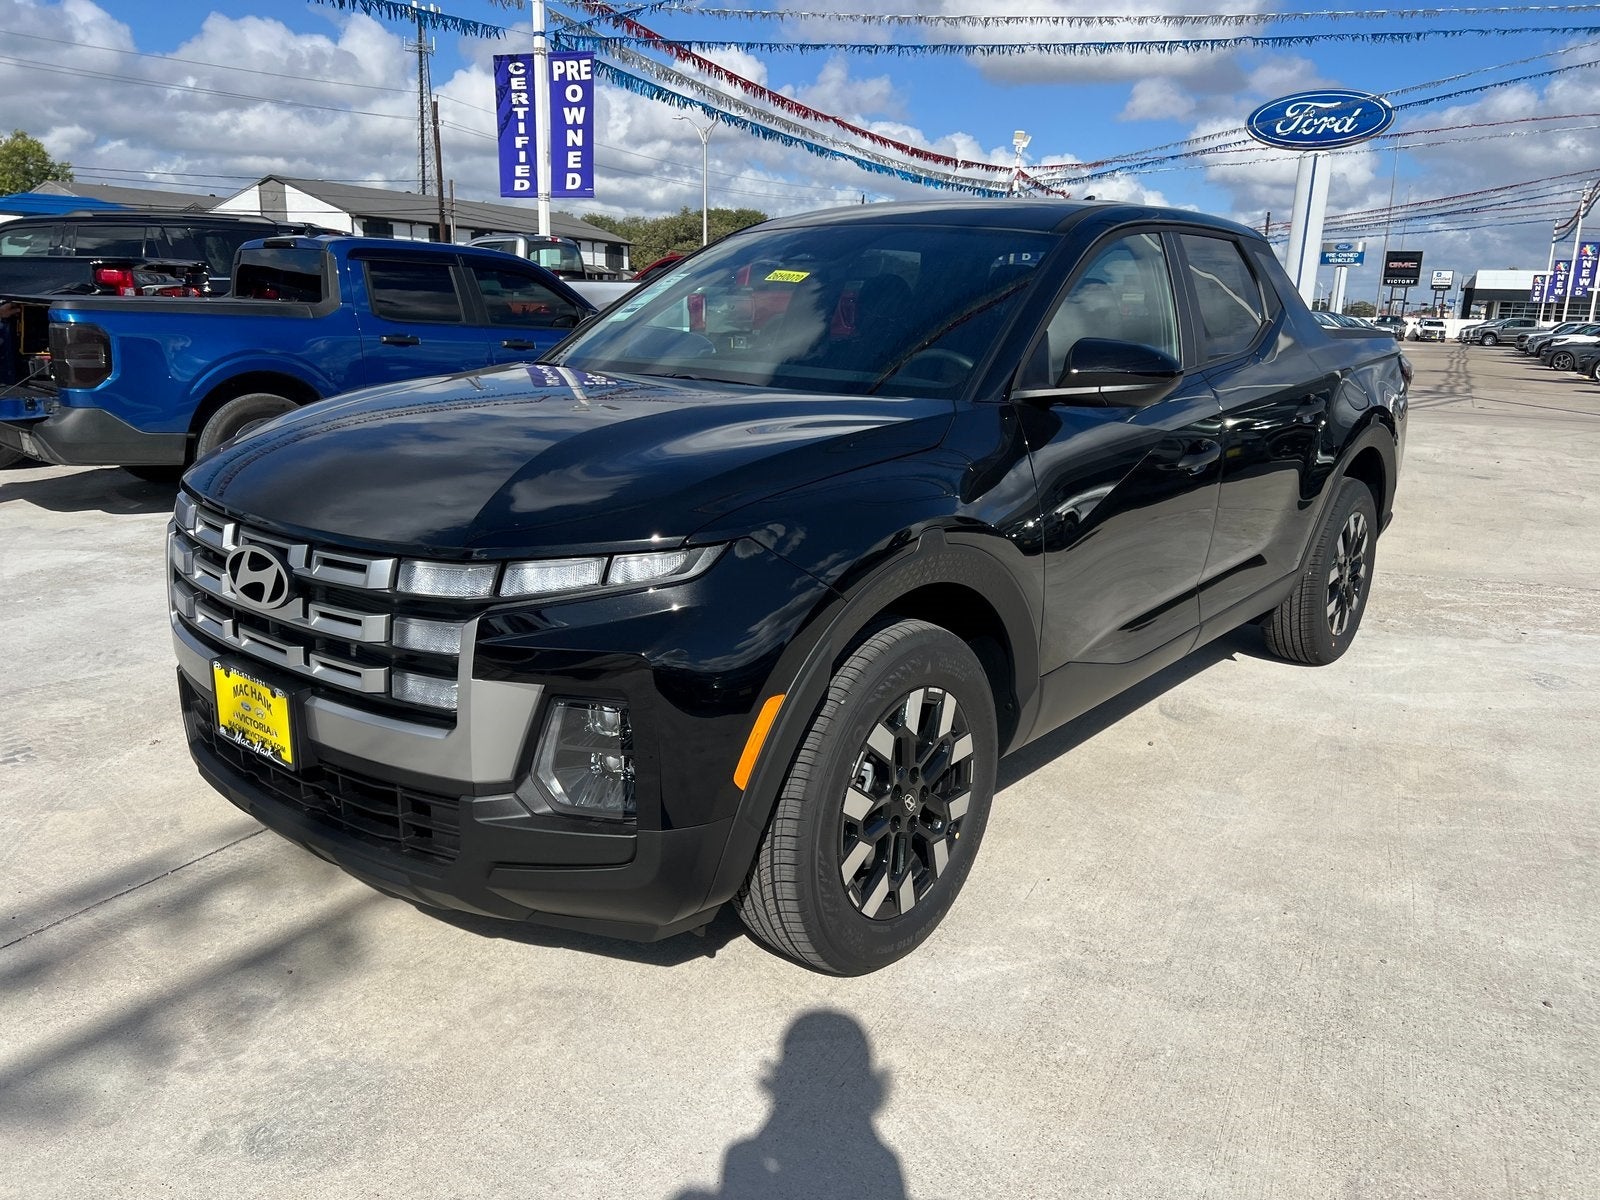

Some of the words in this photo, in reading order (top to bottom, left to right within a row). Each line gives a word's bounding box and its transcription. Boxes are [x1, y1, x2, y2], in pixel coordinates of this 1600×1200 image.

[552, 59, 592, 81] PRE
[508, 62, 531, 191] CERTIFIED
[1275, 101, 1362, 136] Ford
[563, 84, 586, 190] OWNED
[1554, 275, 1564, 295] NEW
[1578, 260, 1592, 286] NEW
[1532, 285, 1541, 302] NEW
[232, 683, 249, 699] MAC
[250, 686, 273, 716] HAIK
[240, 713, 272, 736] VICTORIA
